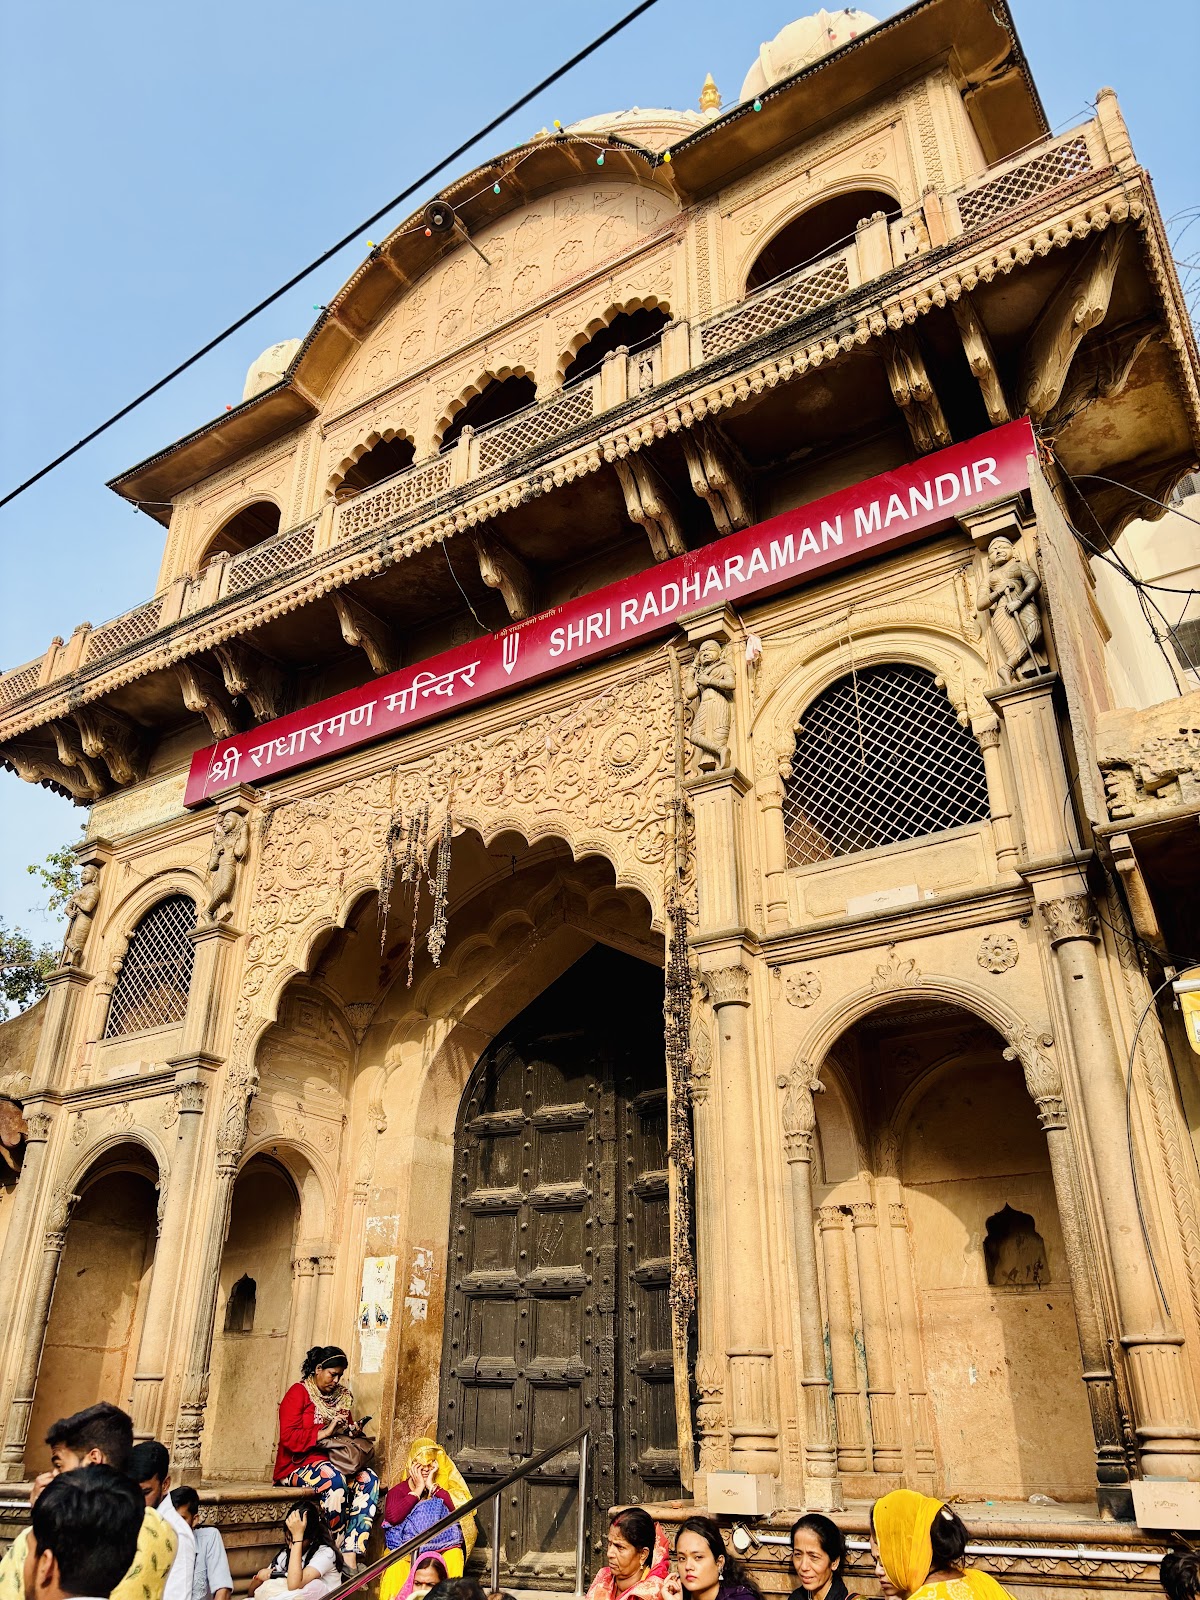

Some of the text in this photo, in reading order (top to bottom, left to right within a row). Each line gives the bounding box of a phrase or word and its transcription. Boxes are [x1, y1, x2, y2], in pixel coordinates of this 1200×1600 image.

[548, 457, 1002, 657] SHRI RADHARAMAN MANDIR
[208, 660, 481, 784] श्री राधारमण मन्दिर
